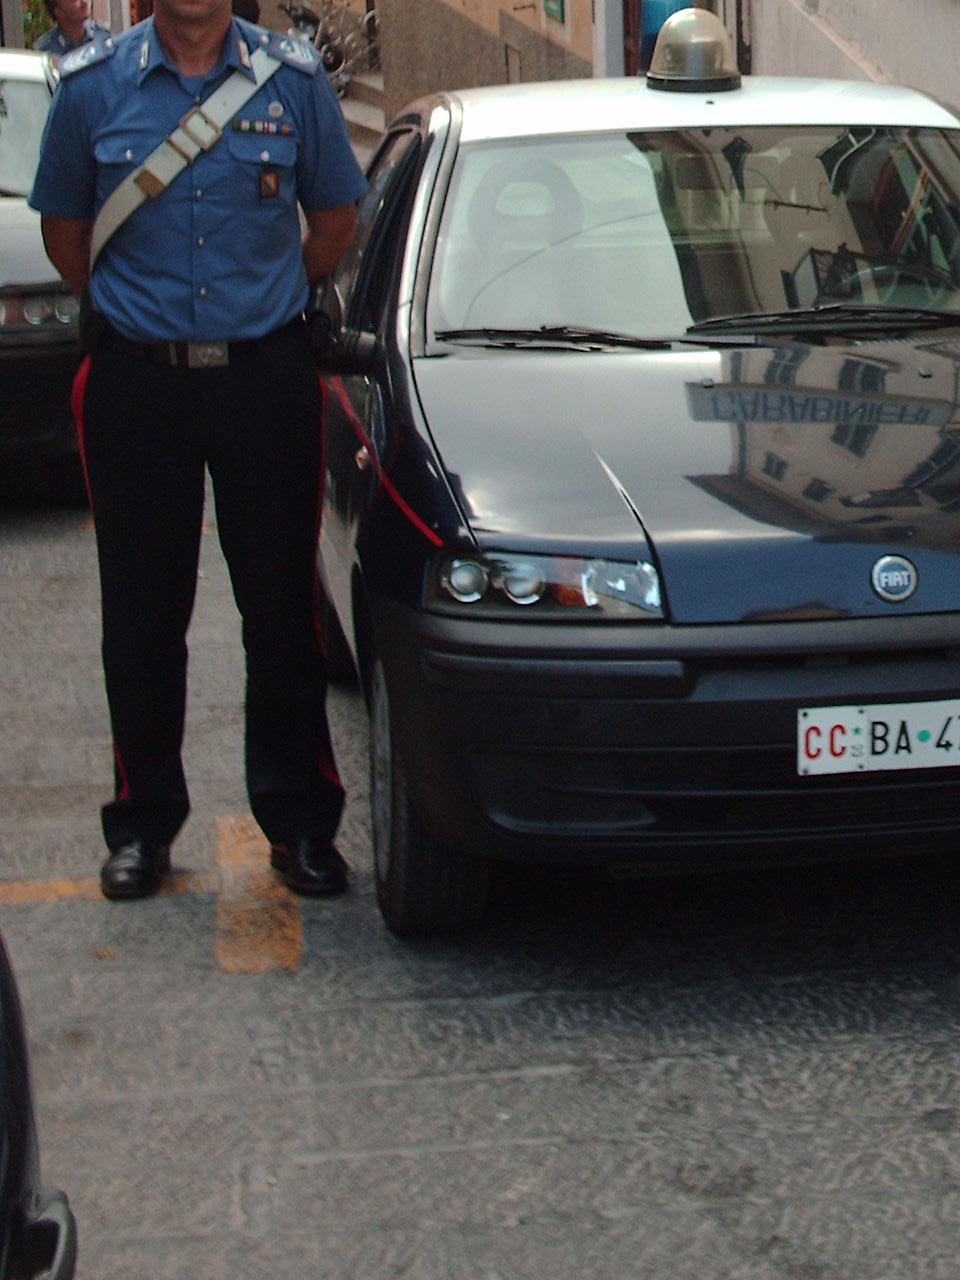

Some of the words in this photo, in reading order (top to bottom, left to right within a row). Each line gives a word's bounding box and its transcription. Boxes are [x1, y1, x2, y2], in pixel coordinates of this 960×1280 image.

[879, 571, 910, 588] FIAT
[805, 724, 847, 760] CC
[871, 720, 912, 755] BA
